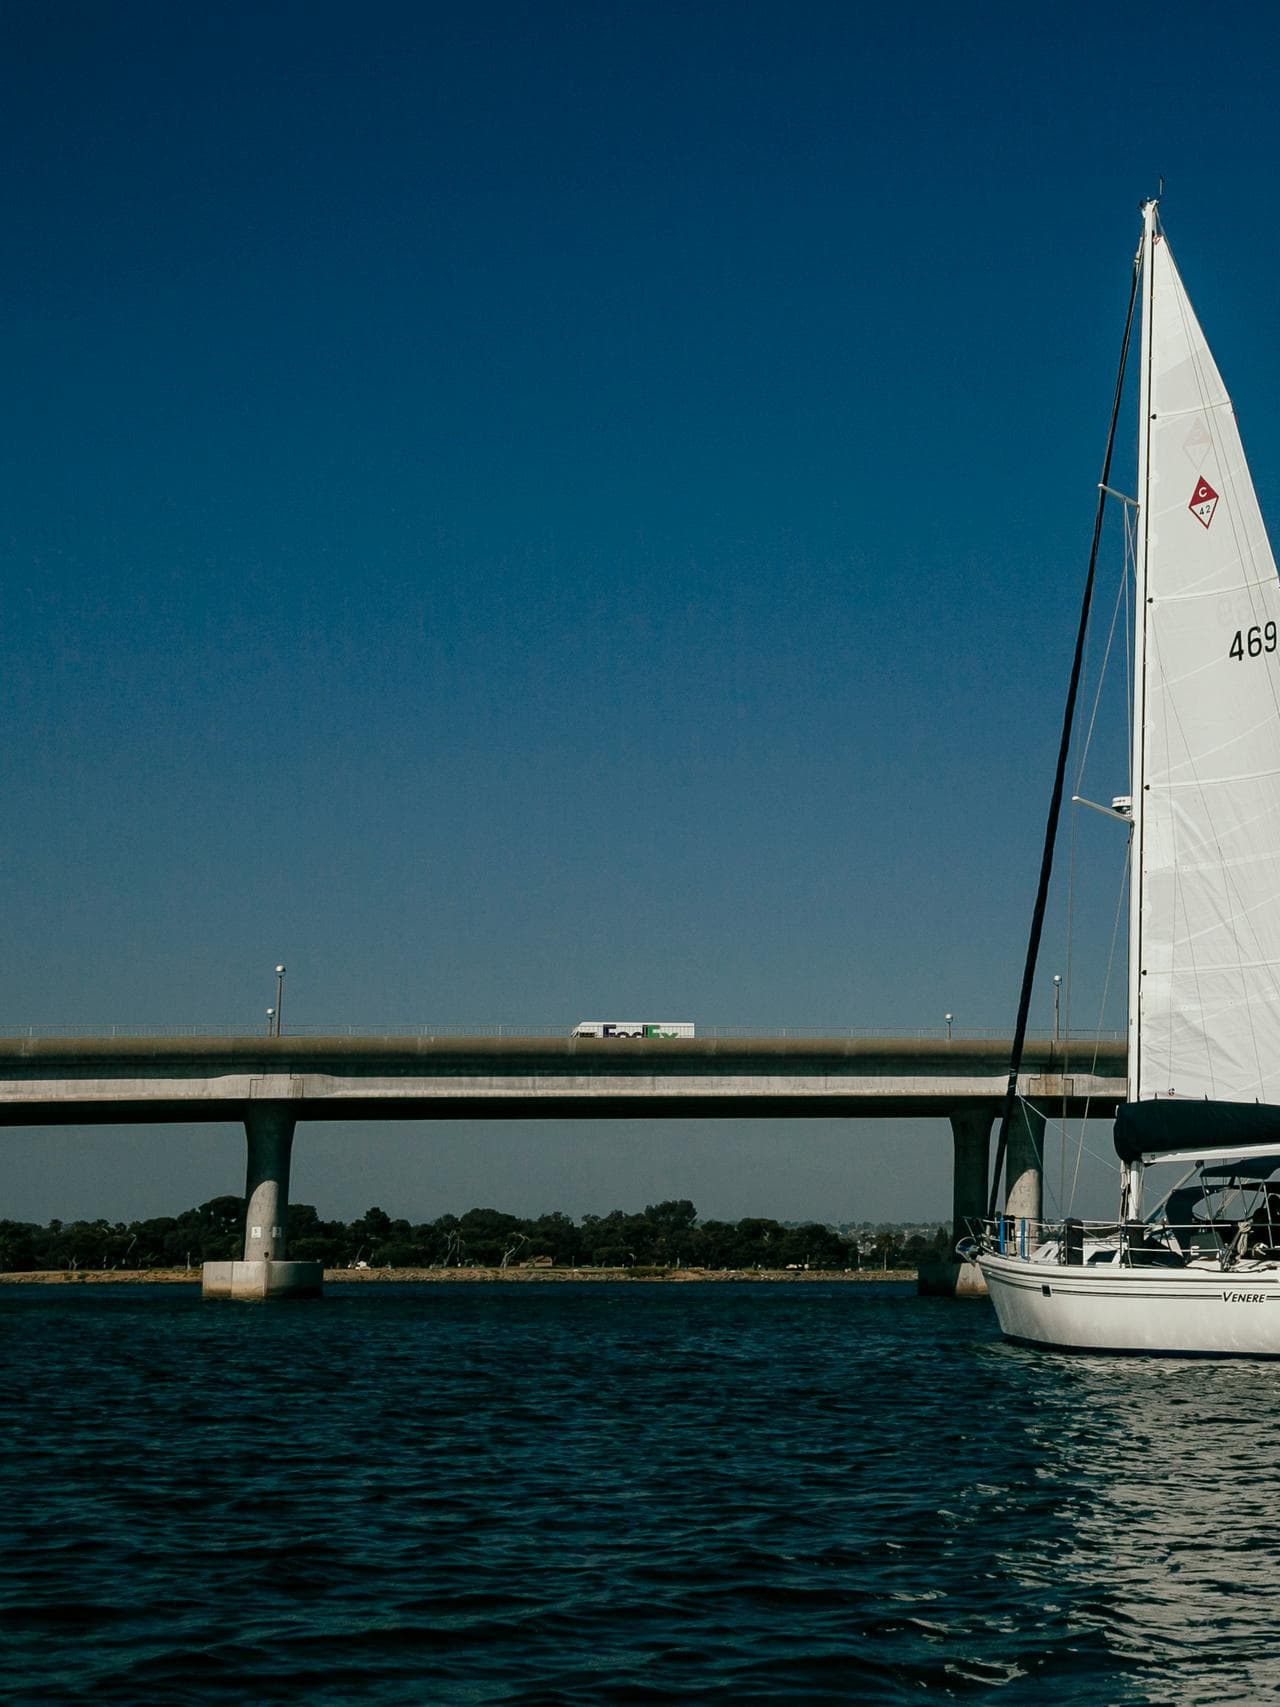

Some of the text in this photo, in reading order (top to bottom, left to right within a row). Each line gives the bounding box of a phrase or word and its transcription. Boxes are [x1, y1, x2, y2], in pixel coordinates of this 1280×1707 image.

[1198, 486, 1208, 497] C
[1199, 504, 1211, 515] 42
[1228, 620, 1277, 662] 469
